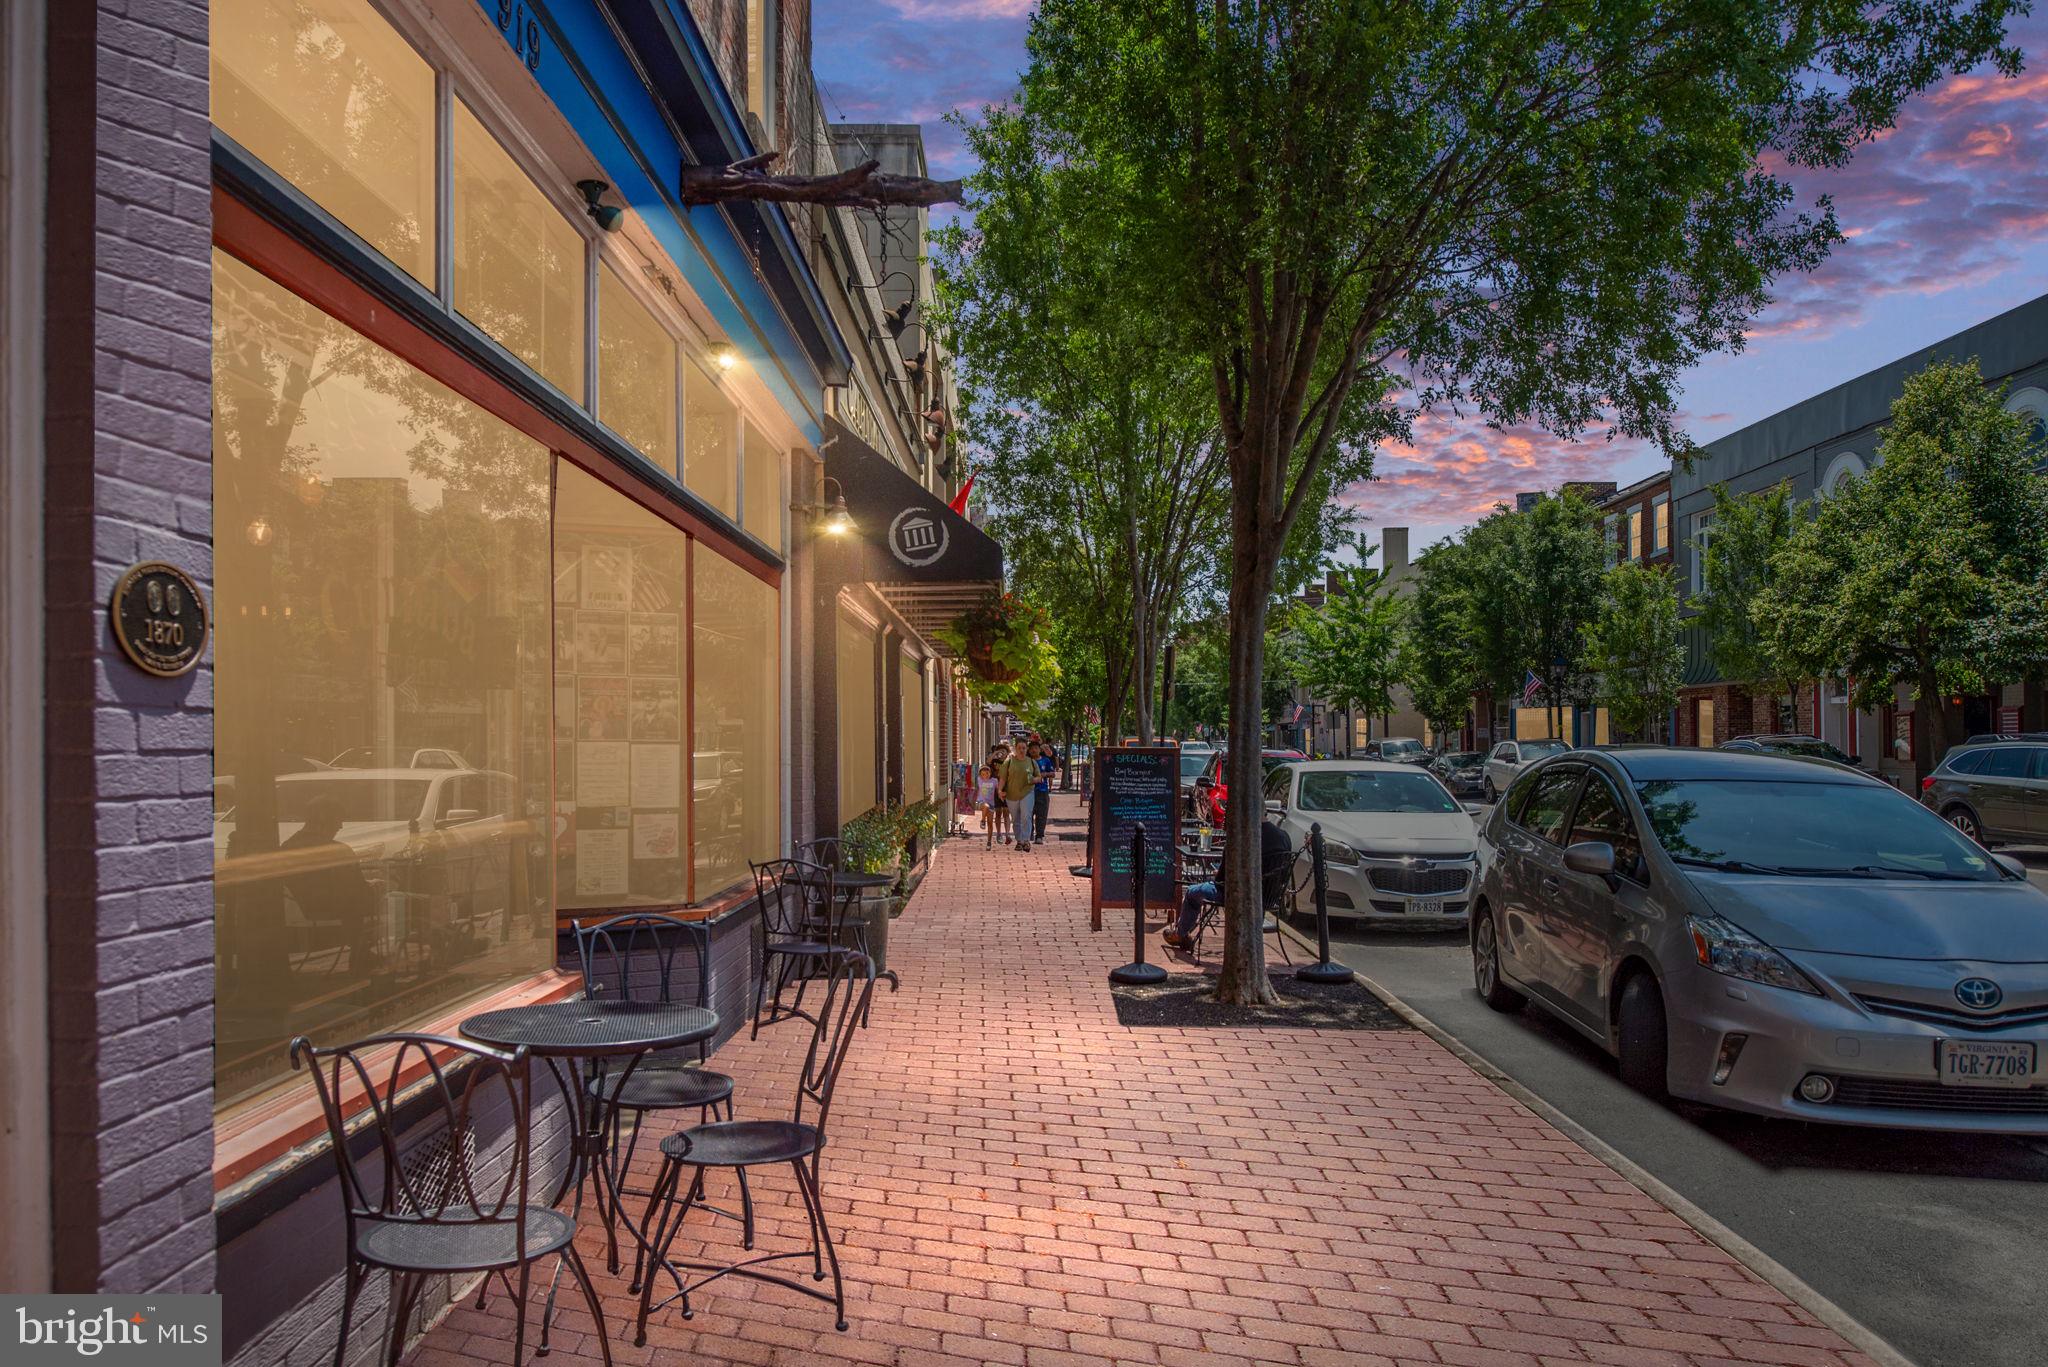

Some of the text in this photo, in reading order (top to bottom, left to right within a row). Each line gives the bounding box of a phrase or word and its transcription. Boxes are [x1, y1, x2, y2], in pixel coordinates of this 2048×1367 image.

[144, 618, 184, 646] 1870
[1966, 1044, 2009, 1054] VIRGINIA
[1948, 1053, 2028, 1076] TGR-7708
